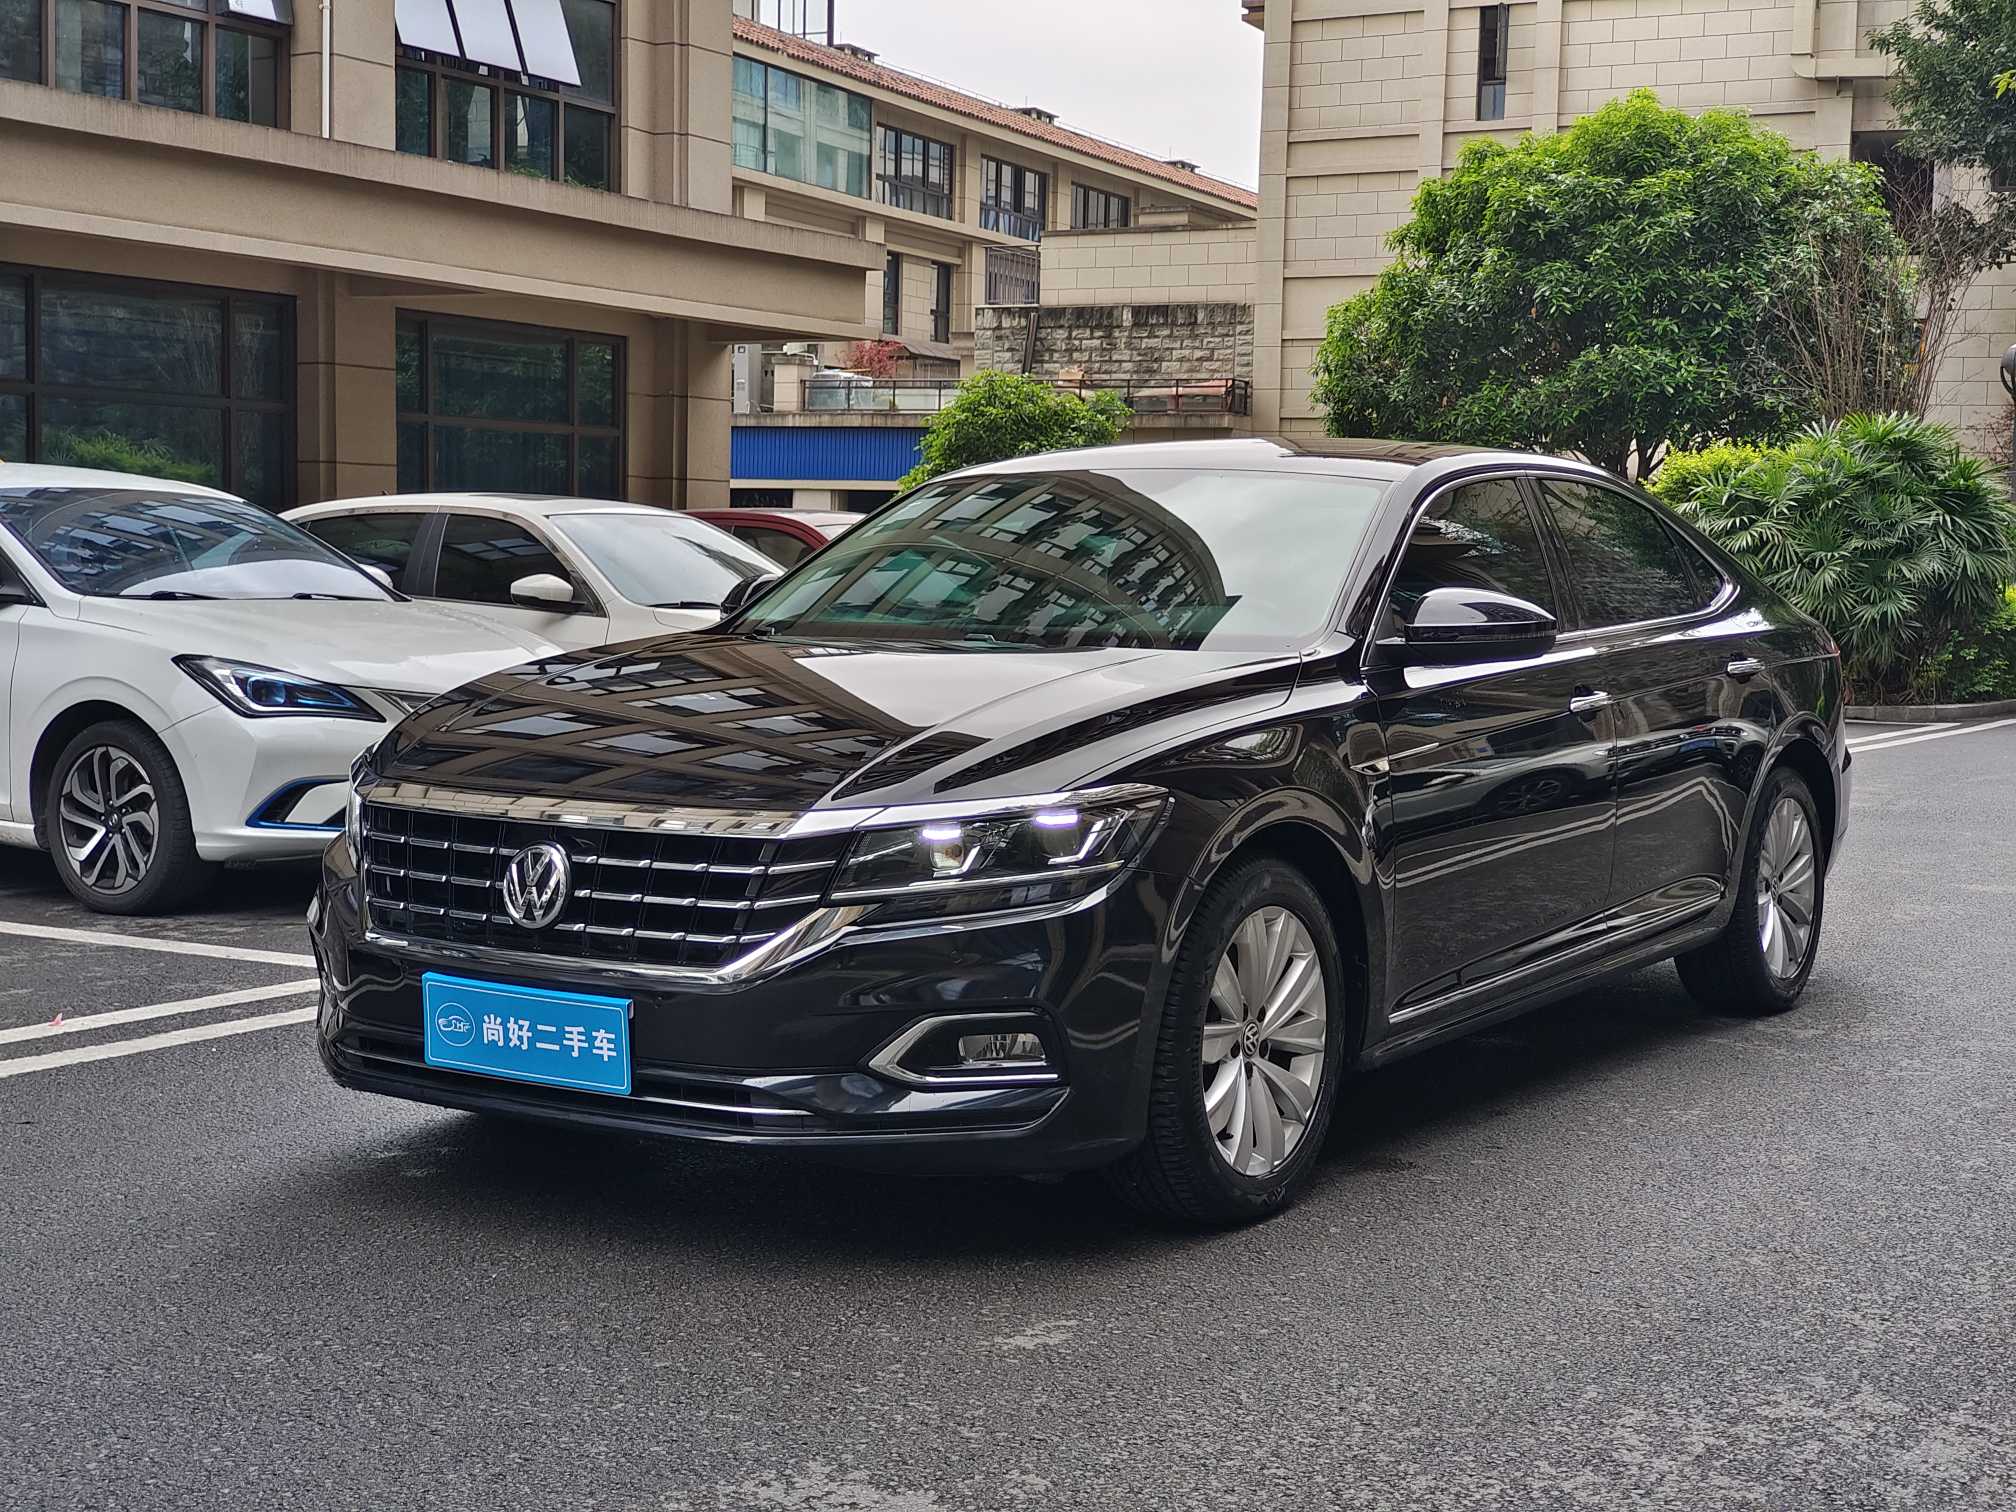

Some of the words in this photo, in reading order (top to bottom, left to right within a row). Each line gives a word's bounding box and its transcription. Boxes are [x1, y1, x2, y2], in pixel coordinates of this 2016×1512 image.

[482, 1014, 617, 1062] 尚好二手车
